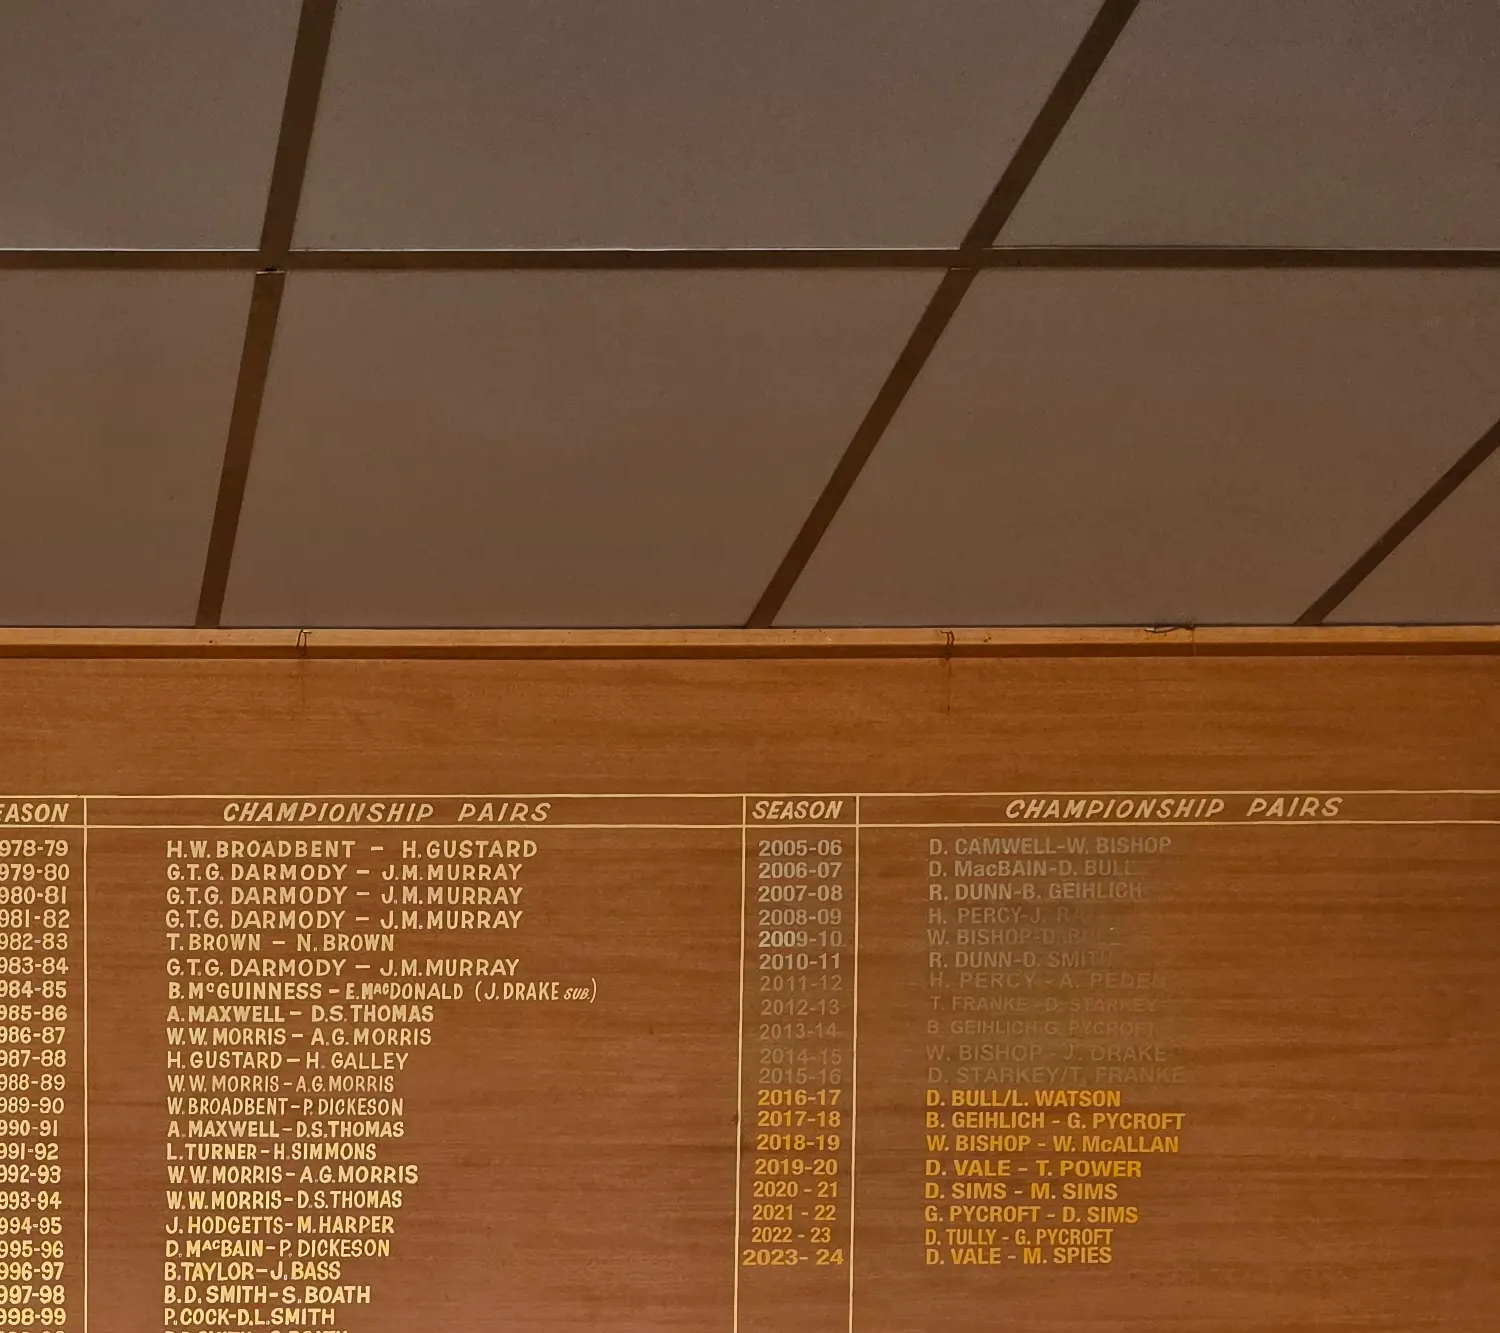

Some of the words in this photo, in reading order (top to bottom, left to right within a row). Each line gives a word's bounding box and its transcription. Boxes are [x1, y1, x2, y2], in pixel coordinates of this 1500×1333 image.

[223, 802, 435, 823] CHAMPIONSHIP
[457, 802, 552, 822] PAIRS
[752, 801, 844, 820] SEASON
[1005, 799, 1226, 819] CHAMPIONSHIP
[1247, 797, 1343, 818] PAIRS
[758, 1089, 842, 1107] 2016-17
[757, 1111, 842, 1129] 2017-18
[754, 1159, 839, 1177] 2019-20
[926, 1160, 948, 1177] D.
[954, 1160, 1012, 1178] VALE
[1036, 1160, 1054, 1178] T.
[1061, 1160, 1143, 1179] POWER
